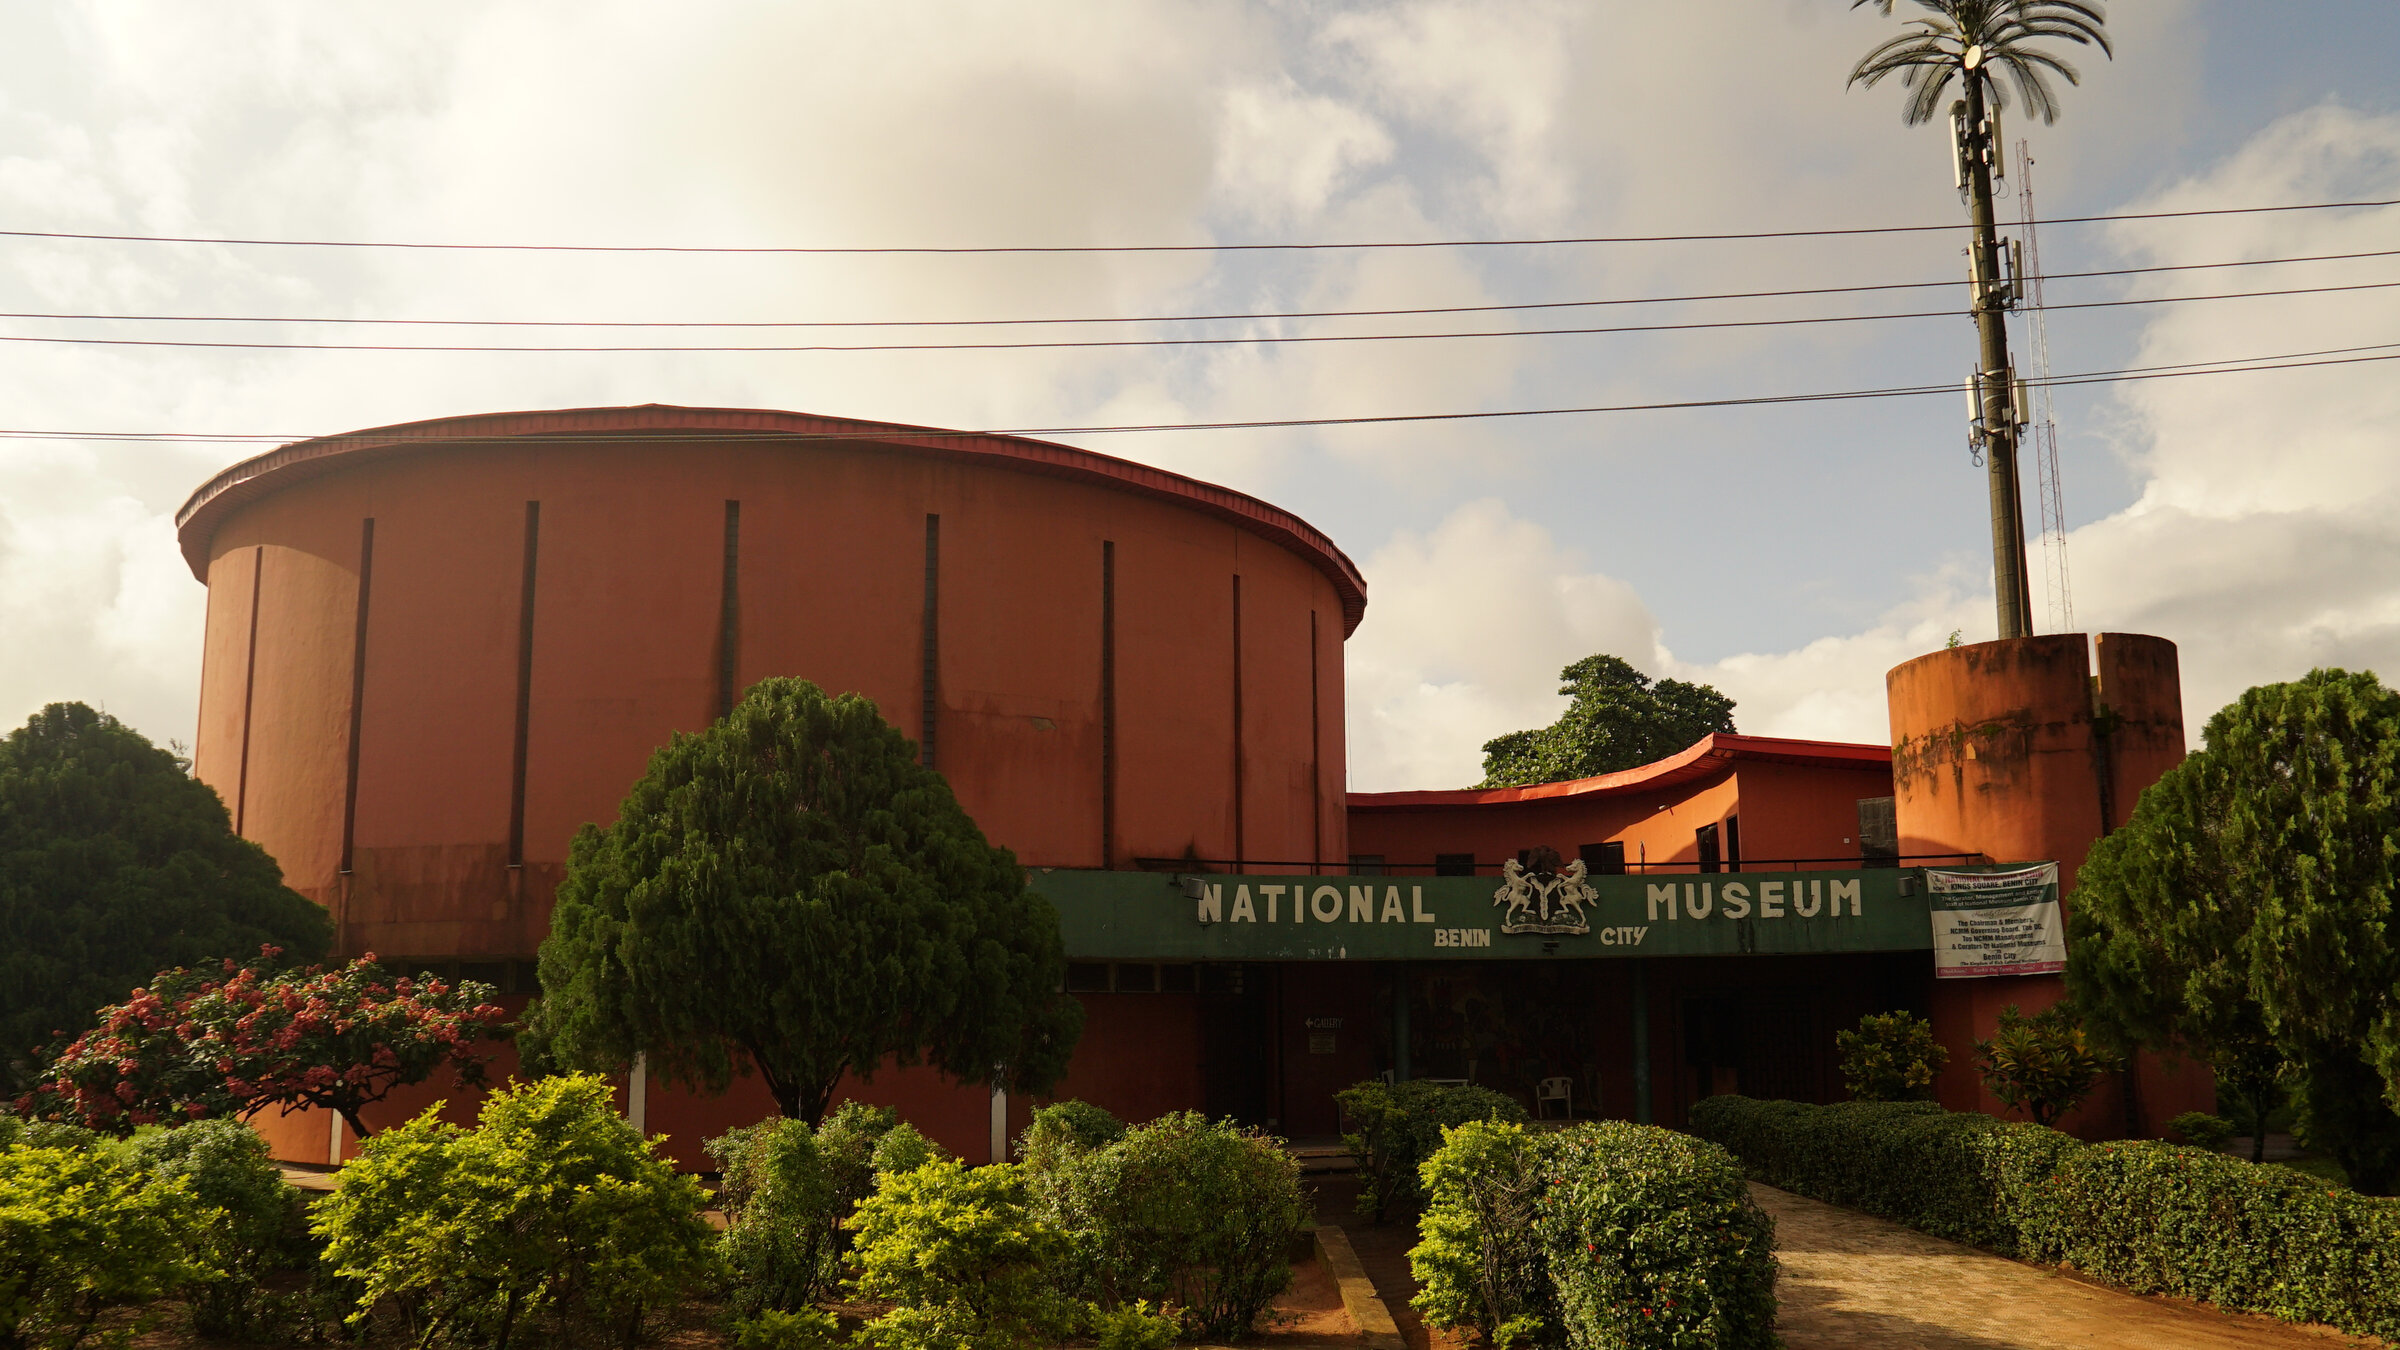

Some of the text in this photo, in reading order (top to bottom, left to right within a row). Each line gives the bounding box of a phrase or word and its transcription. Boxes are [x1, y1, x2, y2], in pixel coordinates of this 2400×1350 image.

[1951, 883, 1971, 891] KINGS
[2003, 879, 2023, 888] BENIN
[2025, 878, 2039, 886] CITY
[1197, 878, 1862, 924] NATIONAL MUSEUM
[1975, 892, 2013, 900] Management
[1434, 928, 1491, 947] BENIN
[1600, 926, 1648, 945] CITY
[1995, 933, 2033, 941] Management
[2018, 939, 2046, 947] Museums
